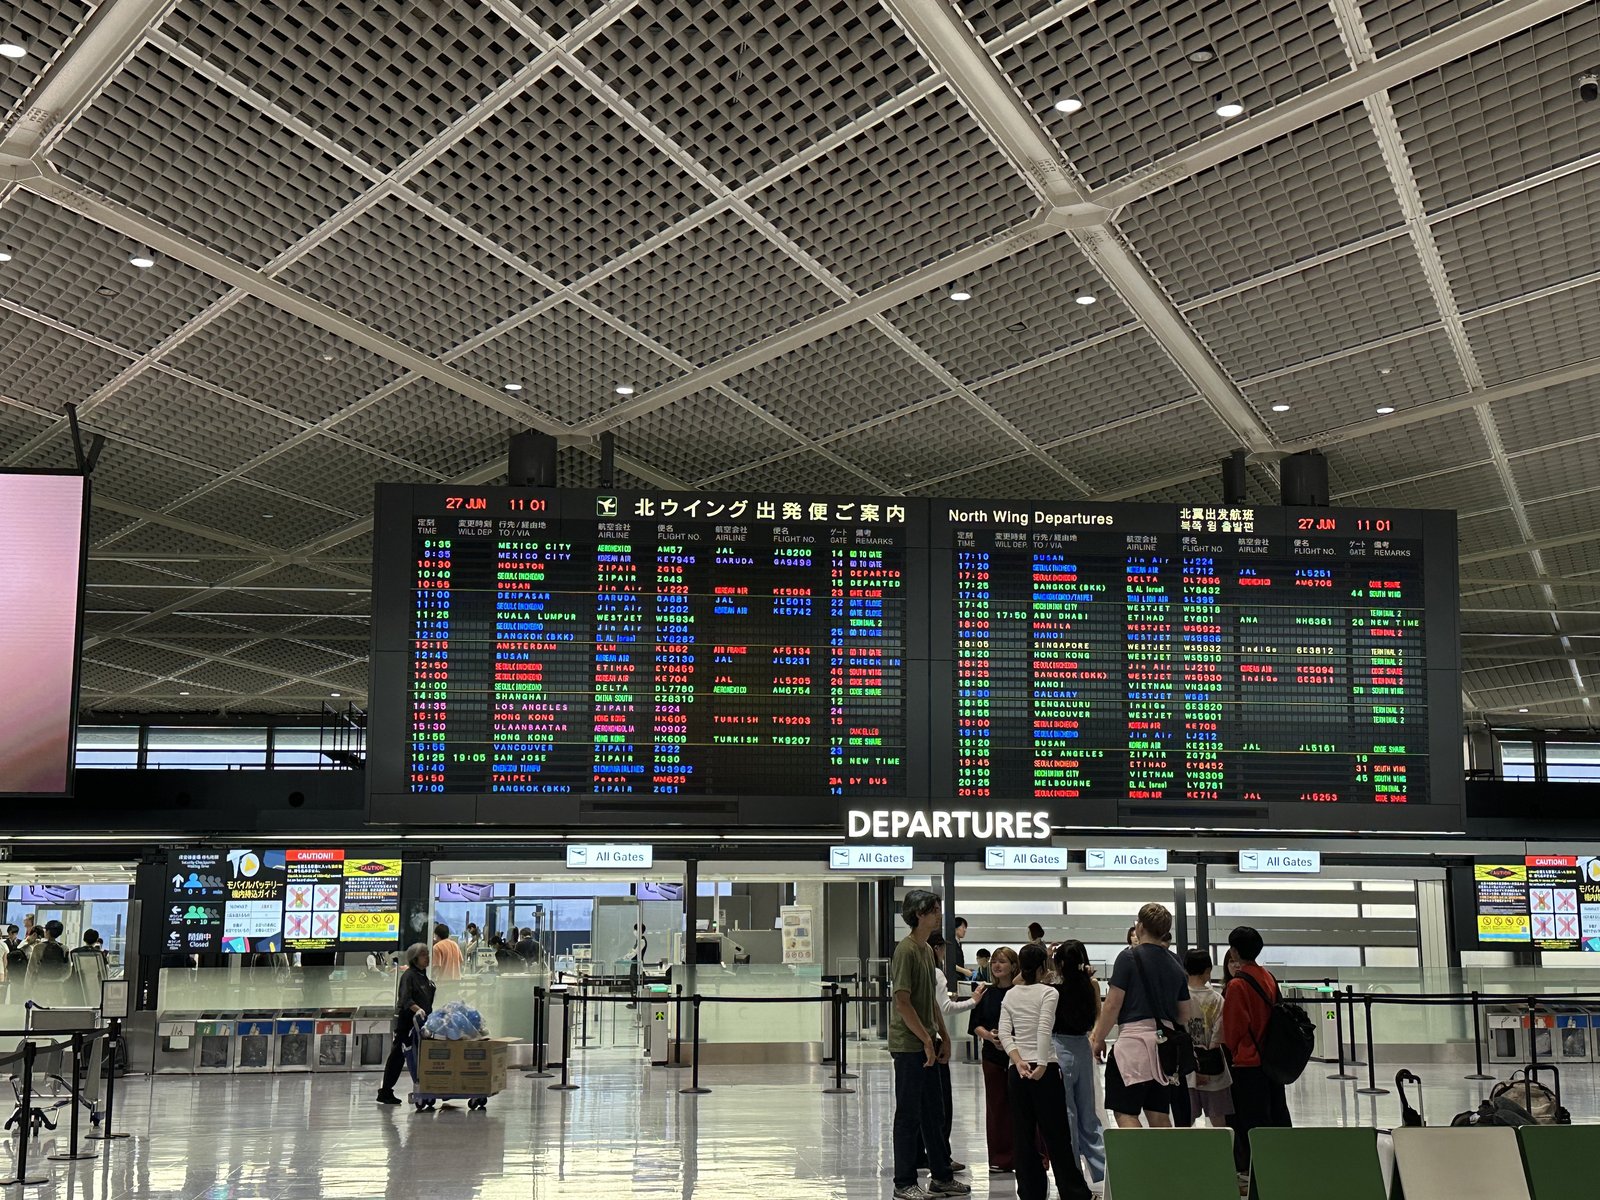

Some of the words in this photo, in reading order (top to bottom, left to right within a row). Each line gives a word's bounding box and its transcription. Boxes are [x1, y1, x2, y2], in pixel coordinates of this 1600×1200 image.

[446, 498, 463, 509] 27
[466, 498, 487, 509] JUN
[949, 510, 988, 522] North
[993, 510, 1029, 525] Wing
[1035, 511, 1114, 525] Departures
[1180, 508, 1254, 520] 北翼出发航班
[598, 523, 630, 531] 航空会社
[1222, 522, 1254, 532] 출발편
[1298, 519, 1314, 530] 27
[1316, 519, 1335, 530] JUN
[1183, 537, 1197, 545] 便名
[1238, 538, 1269, 546] 航空会社
[498, 542, 538, 550] MEXICO
[1183, 545, 1209, 553] FLIGHT
[716, 547, 734, 555] JAL
[498, 552, 538, 560] MEXICO
[959, 553, 989, 561] 17:10
[498, 562, 544, 570] HOUSTON
[598, 564, 636, 572] ZIPAIR
[598, 574, 636, 582] ZIPAIR
[850, 570, 900, 578] DEPARTED
[498, 582, 531, 590] BUSAN
[497, 592, 550, 600] DENPASAR
[959, 592, 989, 600] 17:40
[1127, 604, 1170, 612] WESTJET
[538, 613, 576, 621] LUMPUR
[597, 614, 642, 622] WESTJET
[1034, 612, 1051, 620] ABU
[1396, 619, 1419, 627] TIME
[497, 643, 557, 651] AMSTERDAM
[1035, 641, 1089, 649] SINGAPORE
[1128, 643, 1171, 651] WESTJET
[1066, 651, 1090, 659] KONG
[1128, 653, 1171, 661] WESTJET
[715, 656, 732, 664] JAL
[596, 684, 628, 692] DELTA
[1129, 682, 1172, 690] VIETNAM
[522, 703, 568, 711] ANGELES
[596, 704, 634, 712] ZIPAIR
[495, 713, 520, 721] HONG
[528, 713, 554, 721] KONG
[1035, 710, 1090, 718] VANCOUVER
[1129, 711, 1172, 719] WESTJET
[494, 723, 567, 731] ULAANBAATAR
[494, 733, 520, 741] HONG
[1035, 739, 1065, 747] BUSAN
[1243, 743, 1260, 751] JAL
[595, 744, 633, 752] ZIPAIR
[521, 754, 546, 762] JOSE
[1060, 750, 1103, 758] ANGELES
[850, 757, 869, 765] NEW
[493, 774, 531, 782] TAIPEI
[1130, 770, 1173, 778] VIETNAM
[1035, 779, 1091, 787] MELBOURNE
[848, 809, 1051, 839] DEPARTURES
[596, 851, 611, 862] All
[613, 852, 644, 862] Gates
[858, 852, 872, 862] All
[875, 853, 905, 863] Gates
[1013, 853, 1026, 863] All
[1029, 854, 1059, 865] Gates
[1114, 854, 1126, 865] All
[1129, 855, 1160, 866] Gates
[1266, 856, 1280, 867] All
[1282, 857, 1312, 868] Gates
[227, 881, 283, 889] モバイルバッテリー
